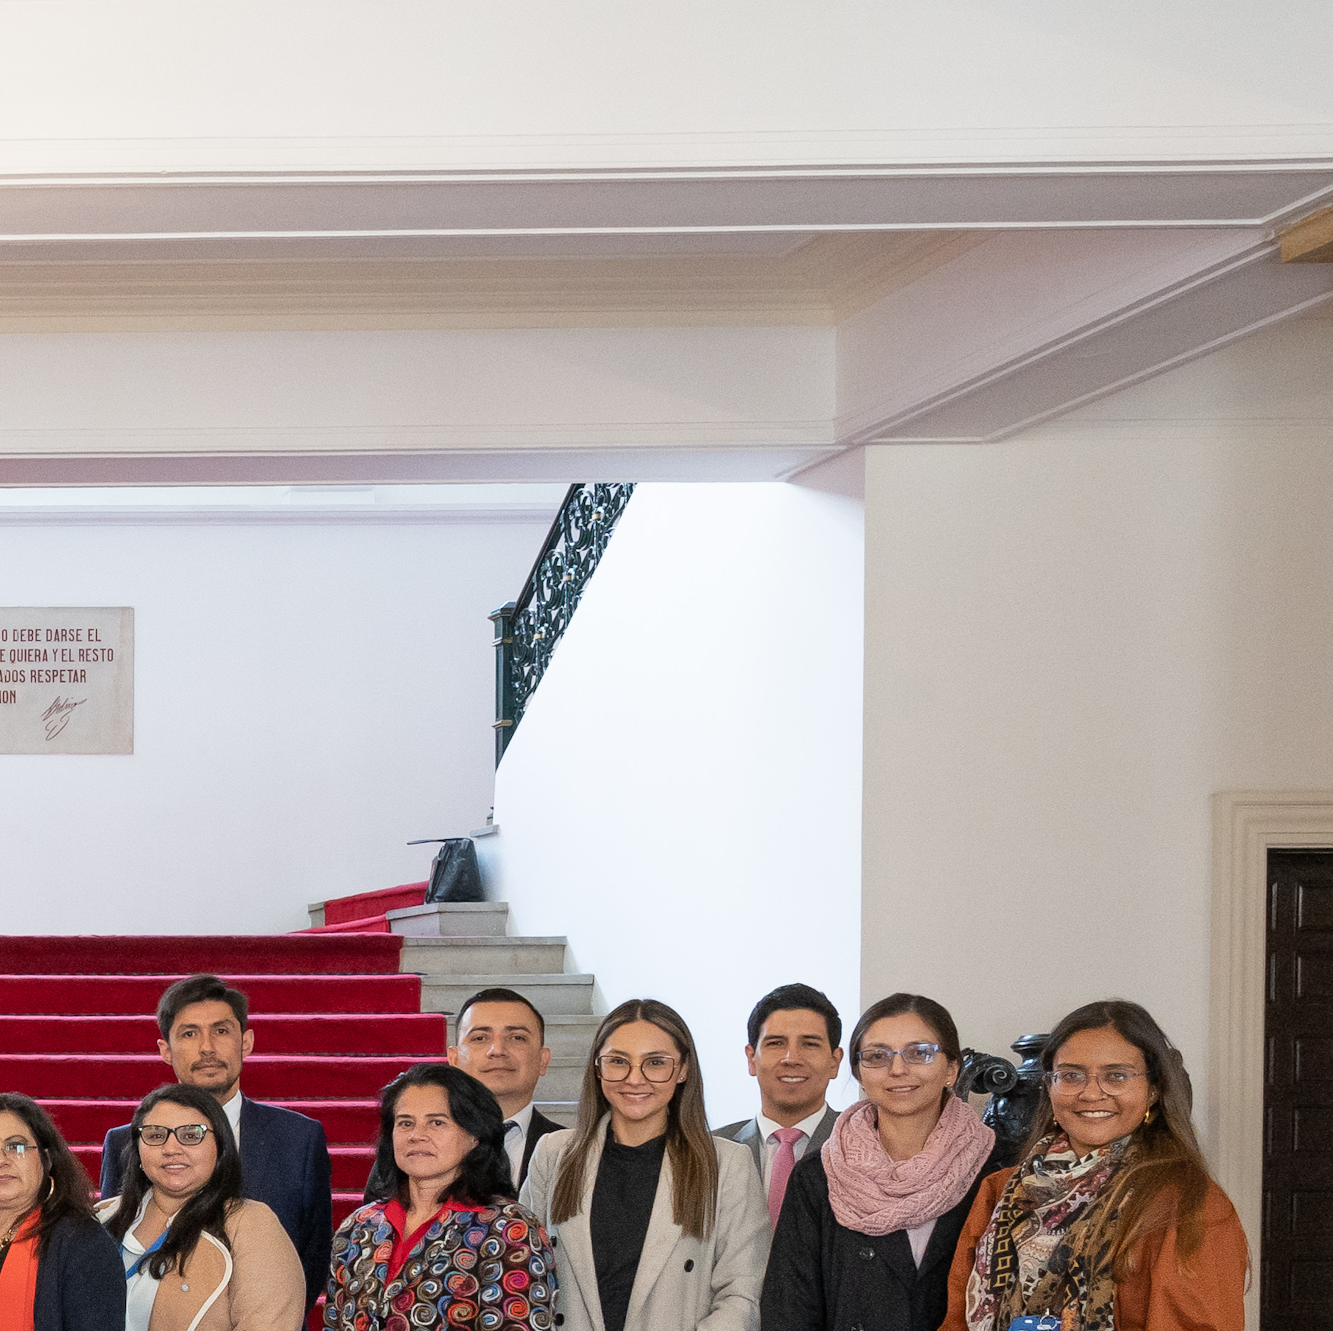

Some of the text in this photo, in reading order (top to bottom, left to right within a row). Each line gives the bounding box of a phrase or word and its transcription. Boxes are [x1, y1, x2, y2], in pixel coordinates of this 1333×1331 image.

[12, 628, 42, 643] DEBE
[45, 628, 83, 643] DARSE
[87, 628, 102, 643] EL
[9, 648, 49, 665] QUIERA
[52, 648, 58, 663] Y
[61, 648, 75, 663] EL
[78, 648, 114, 663] RESTO
[29, 669, 87, 684] RESPETAR
